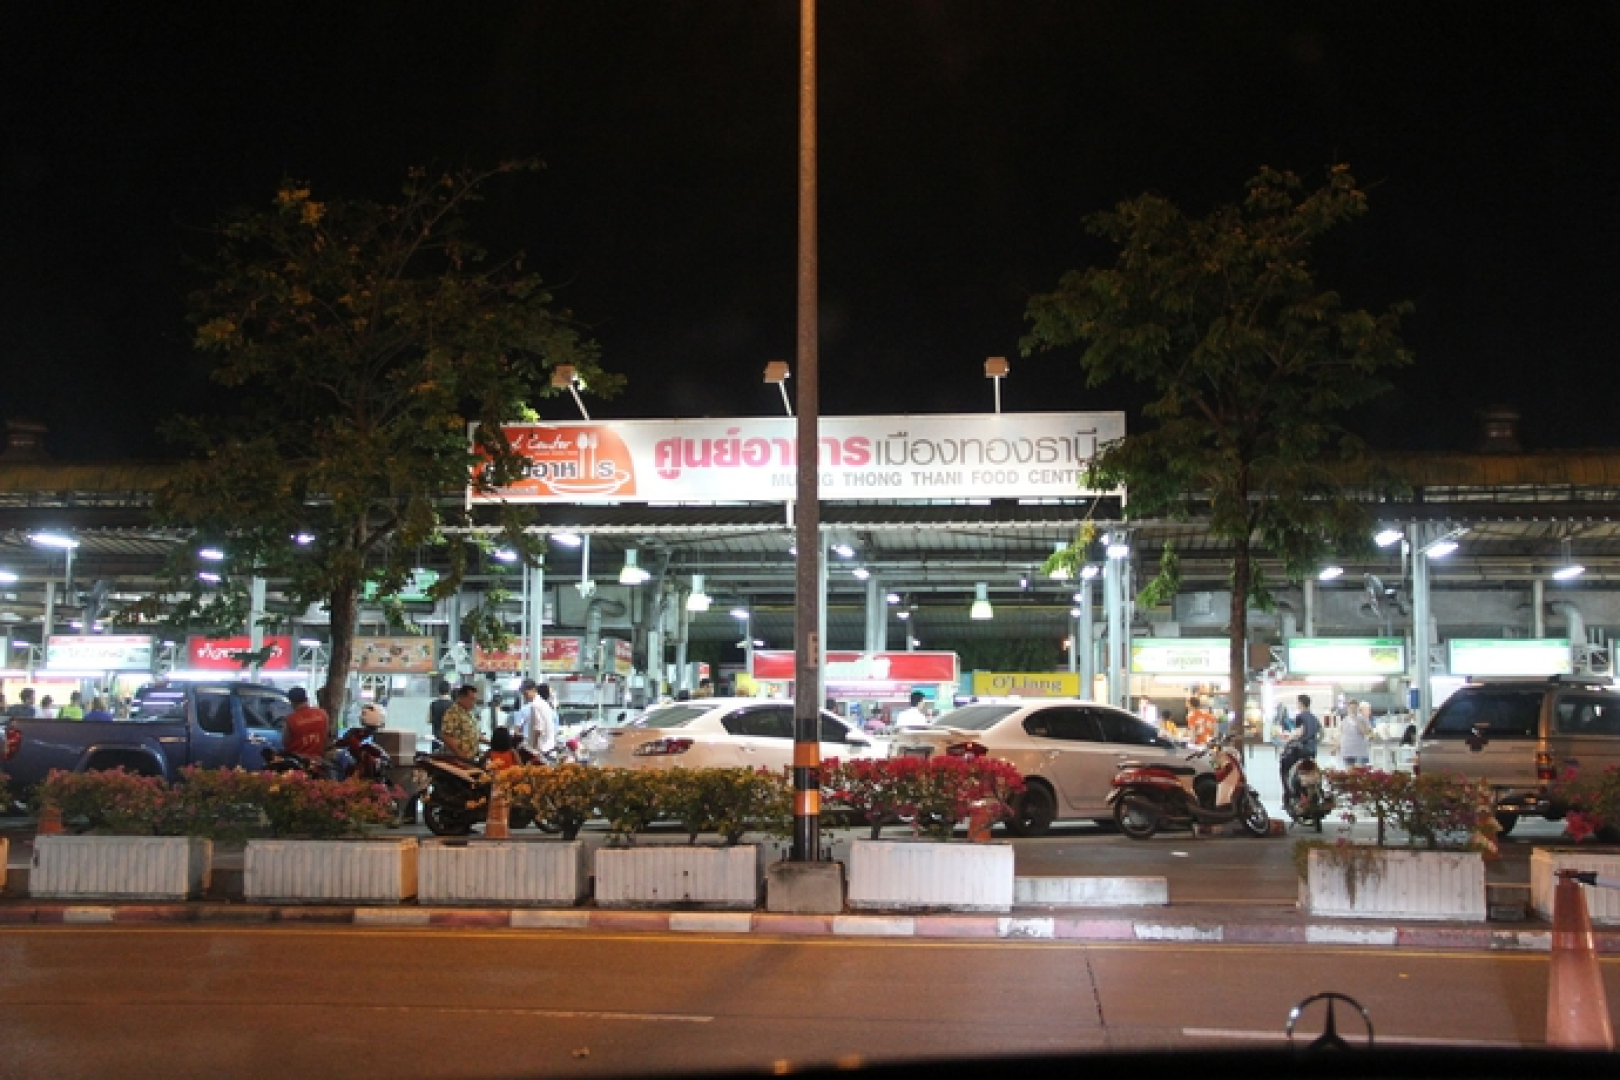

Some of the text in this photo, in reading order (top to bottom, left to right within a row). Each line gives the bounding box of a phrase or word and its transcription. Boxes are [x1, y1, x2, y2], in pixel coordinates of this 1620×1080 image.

[772, 472, 834, 487] MUG
[843, 471, 902, 487] THONG
[911, 471, 963, 486] THANI
[971, 470, 1020, 485] FOOD
